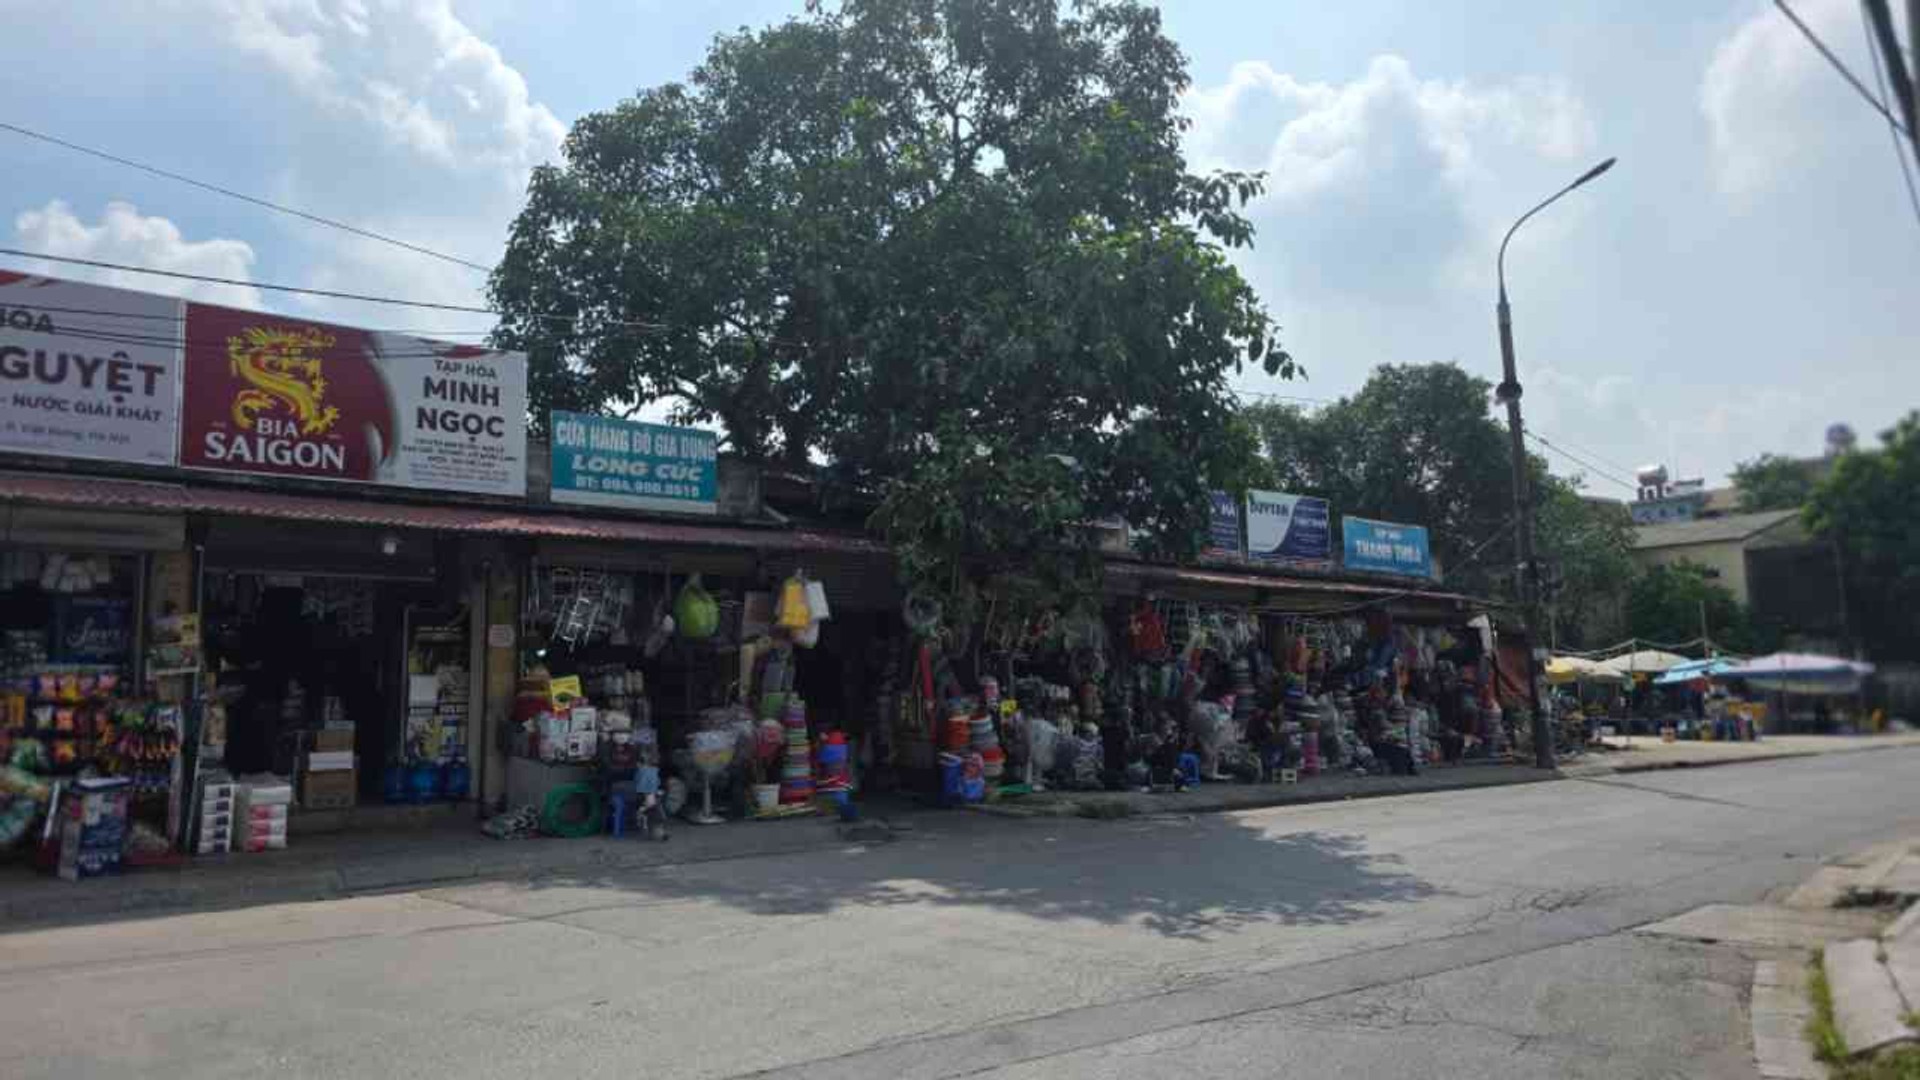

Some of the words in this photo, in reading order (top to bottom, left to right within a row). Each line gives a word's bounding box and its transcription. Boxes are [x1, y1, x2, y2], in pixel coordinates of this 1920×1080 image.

[423, 376, 500, 407] MINH
[256, 417, 298, 438] BIA
[416, 407, 505, 443] NGỌC
[204, 432, 345, 472] SAIGON
[573, 454, 649, 476] LONG
